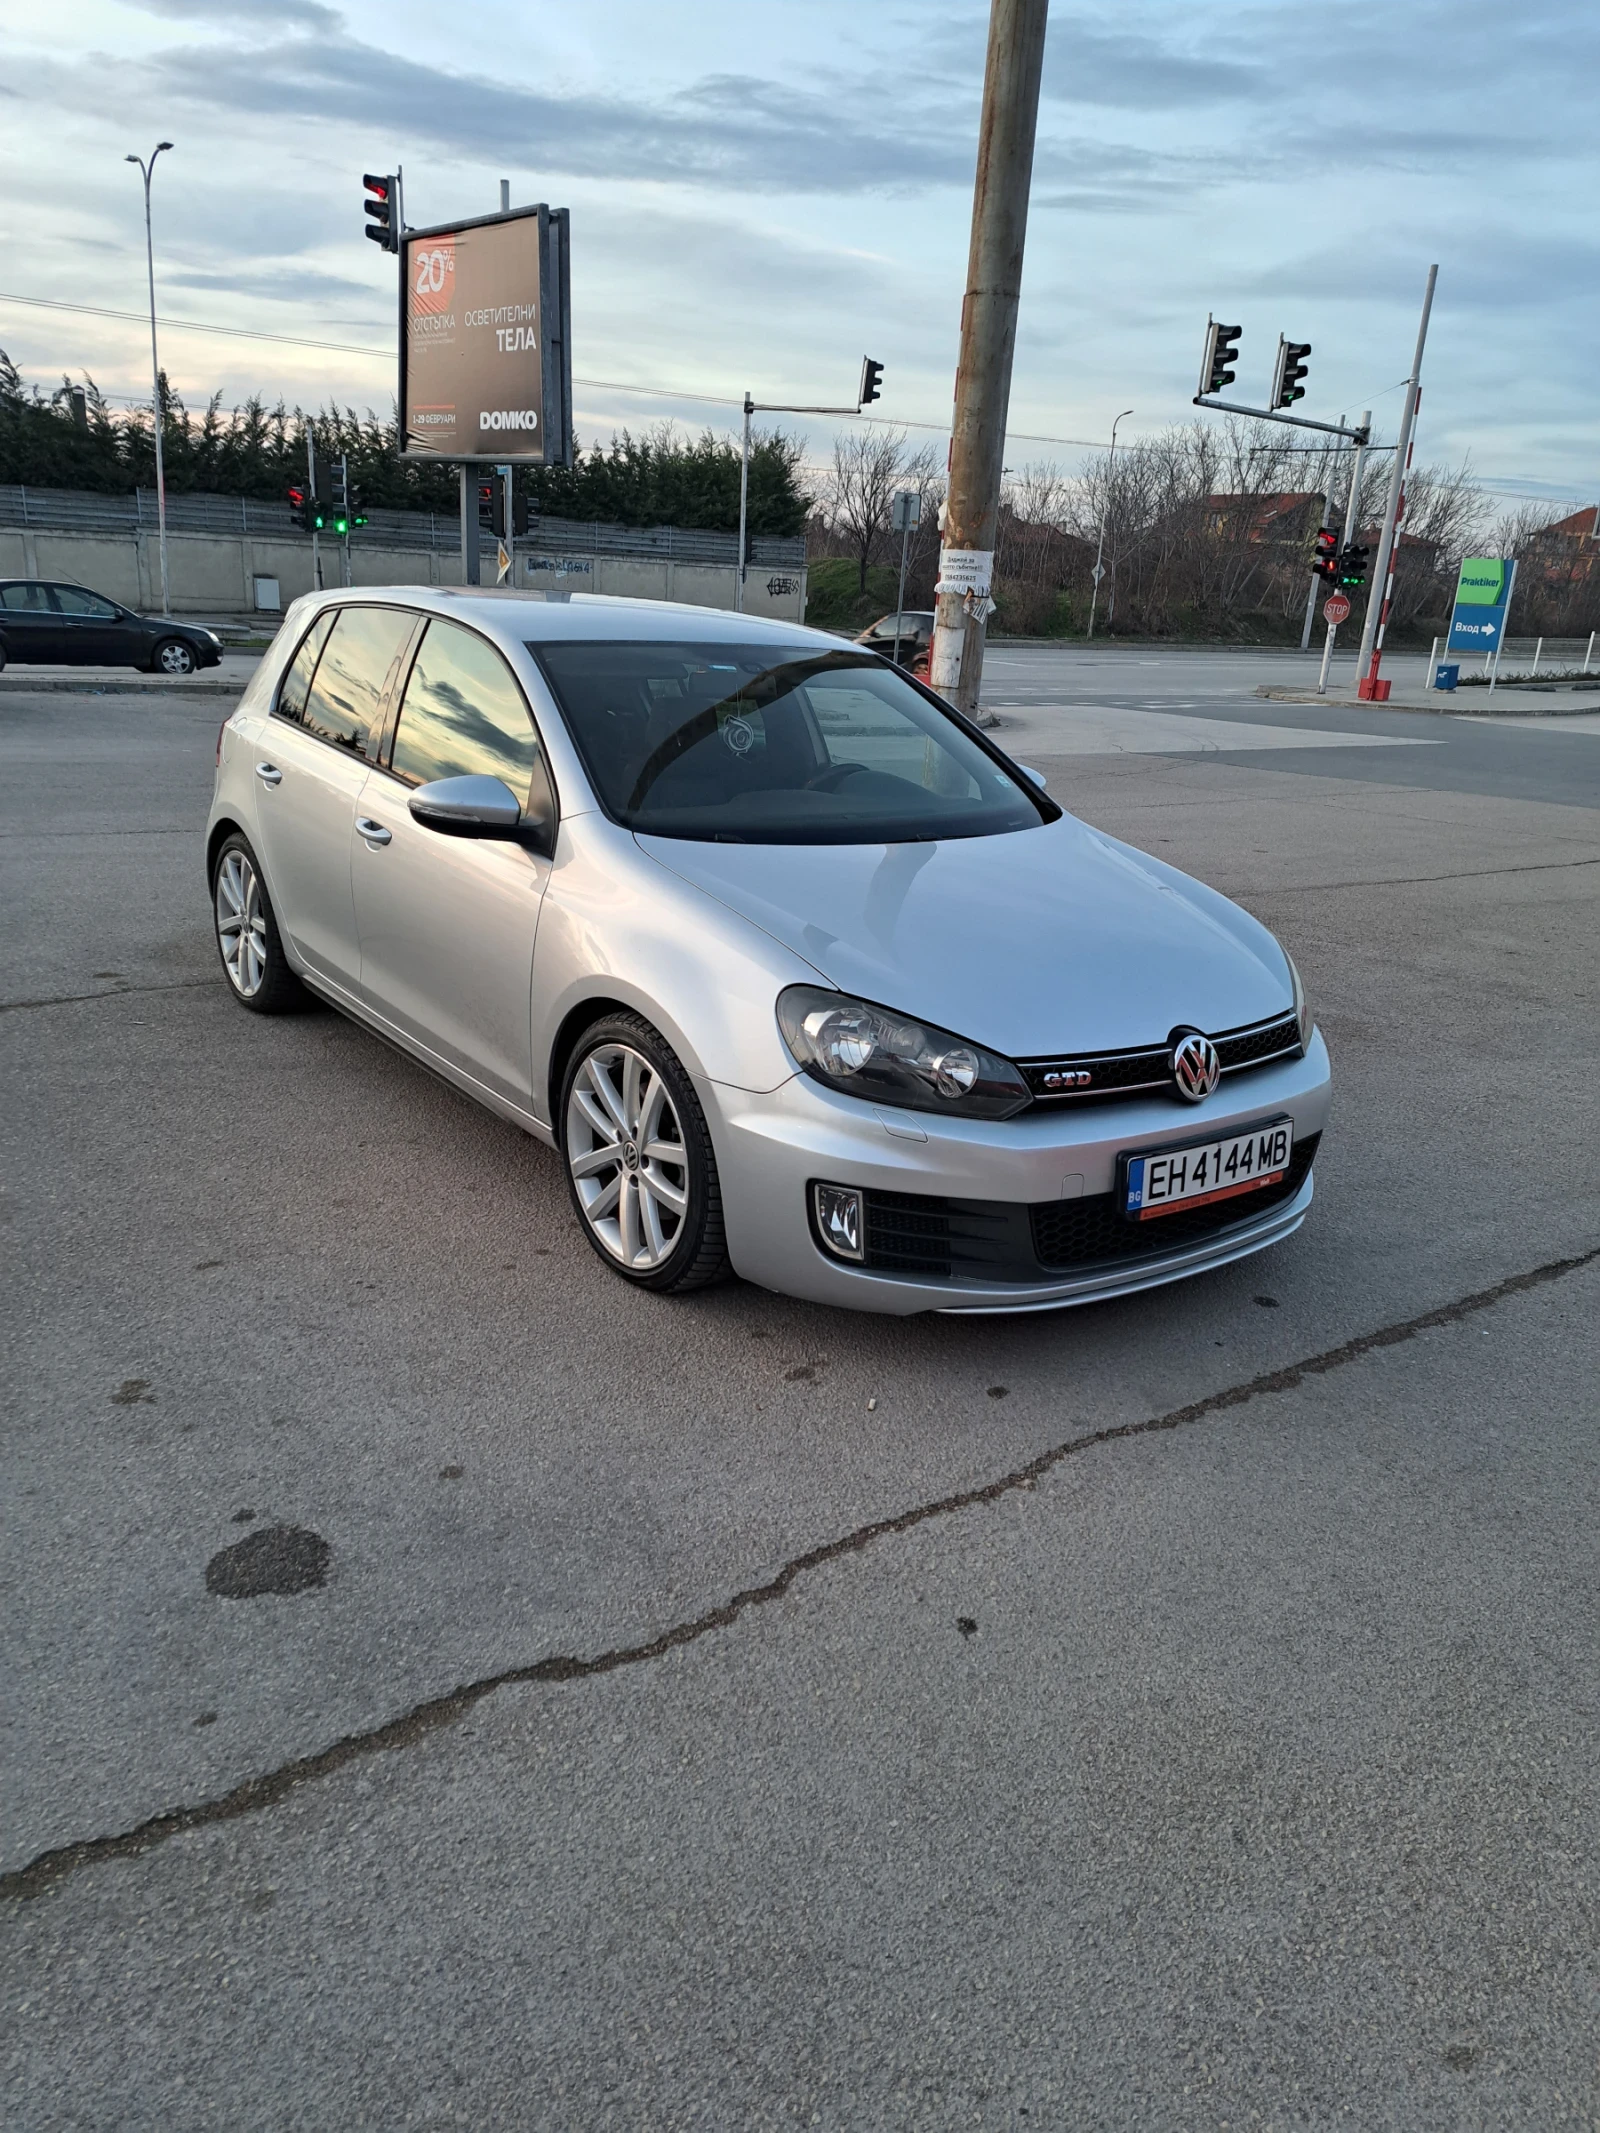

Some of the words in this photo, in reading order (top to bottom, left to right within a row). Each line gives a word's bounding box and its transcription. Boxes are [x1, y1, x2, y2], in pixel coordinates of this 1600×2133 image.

[413, 314, 456, 332] ОТСТЪПКА
[464, 303, 536, 327] ОСВЕТИТЕЛНИ
[496, 326, 537, 352] ТЕЛА
[425, 413, 456, 424] ФЕВРУАРИ
[479, 410, 538, 430] DOMKO
[1461, 577, 1500, 587] Praktiker
[1326, 603, 1348, 615] STOP
[1455, 621, 1480, 635] Вход
[1043, 1070, 1092, 1088] GTD
[1128, 1190, 1142, 1203] BG
